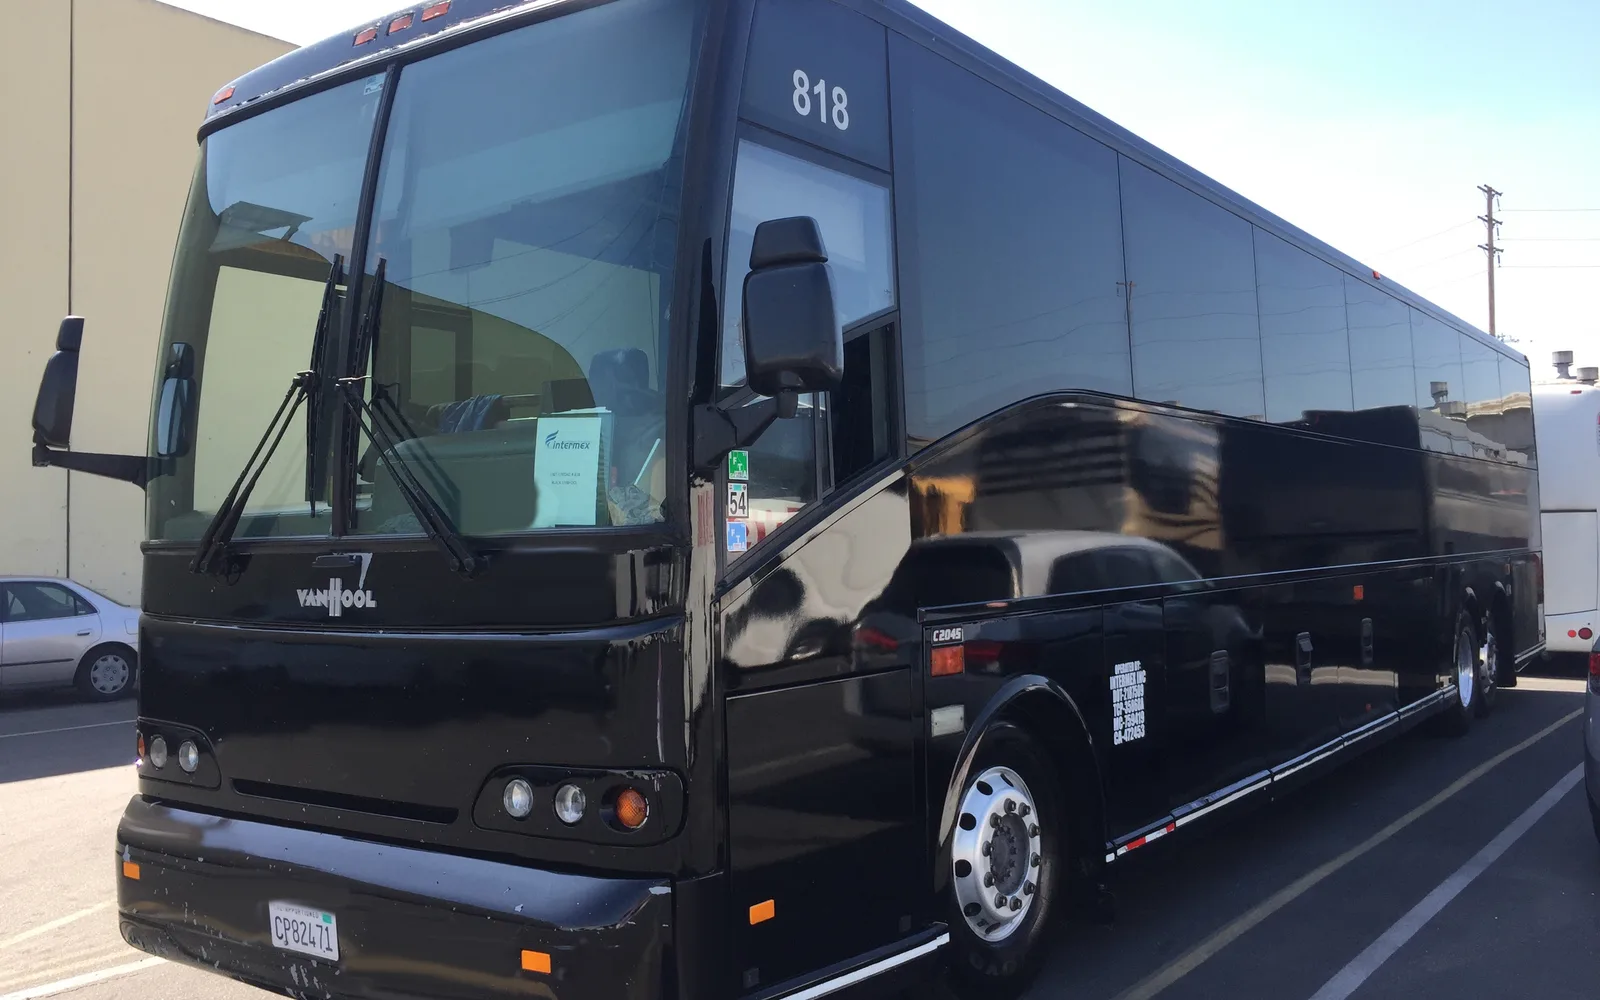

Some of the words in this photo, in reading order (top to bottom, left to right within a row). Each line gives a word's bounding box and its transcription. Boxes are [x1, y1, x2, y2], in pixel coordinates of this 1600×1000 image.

[792, 69, 849, 131] 818
[552, 440, 591, 450] intermex
[730, 491, 746, 515] 54
[933, 627, 962, 642] C2045
[1114, 661, 1135, 675] OPERATED
[1109, 671, 1136, 690] INTERMEX
[1113, 723, 1145, 745] CA-472453
[274, 915, 333, 952] CP82471
